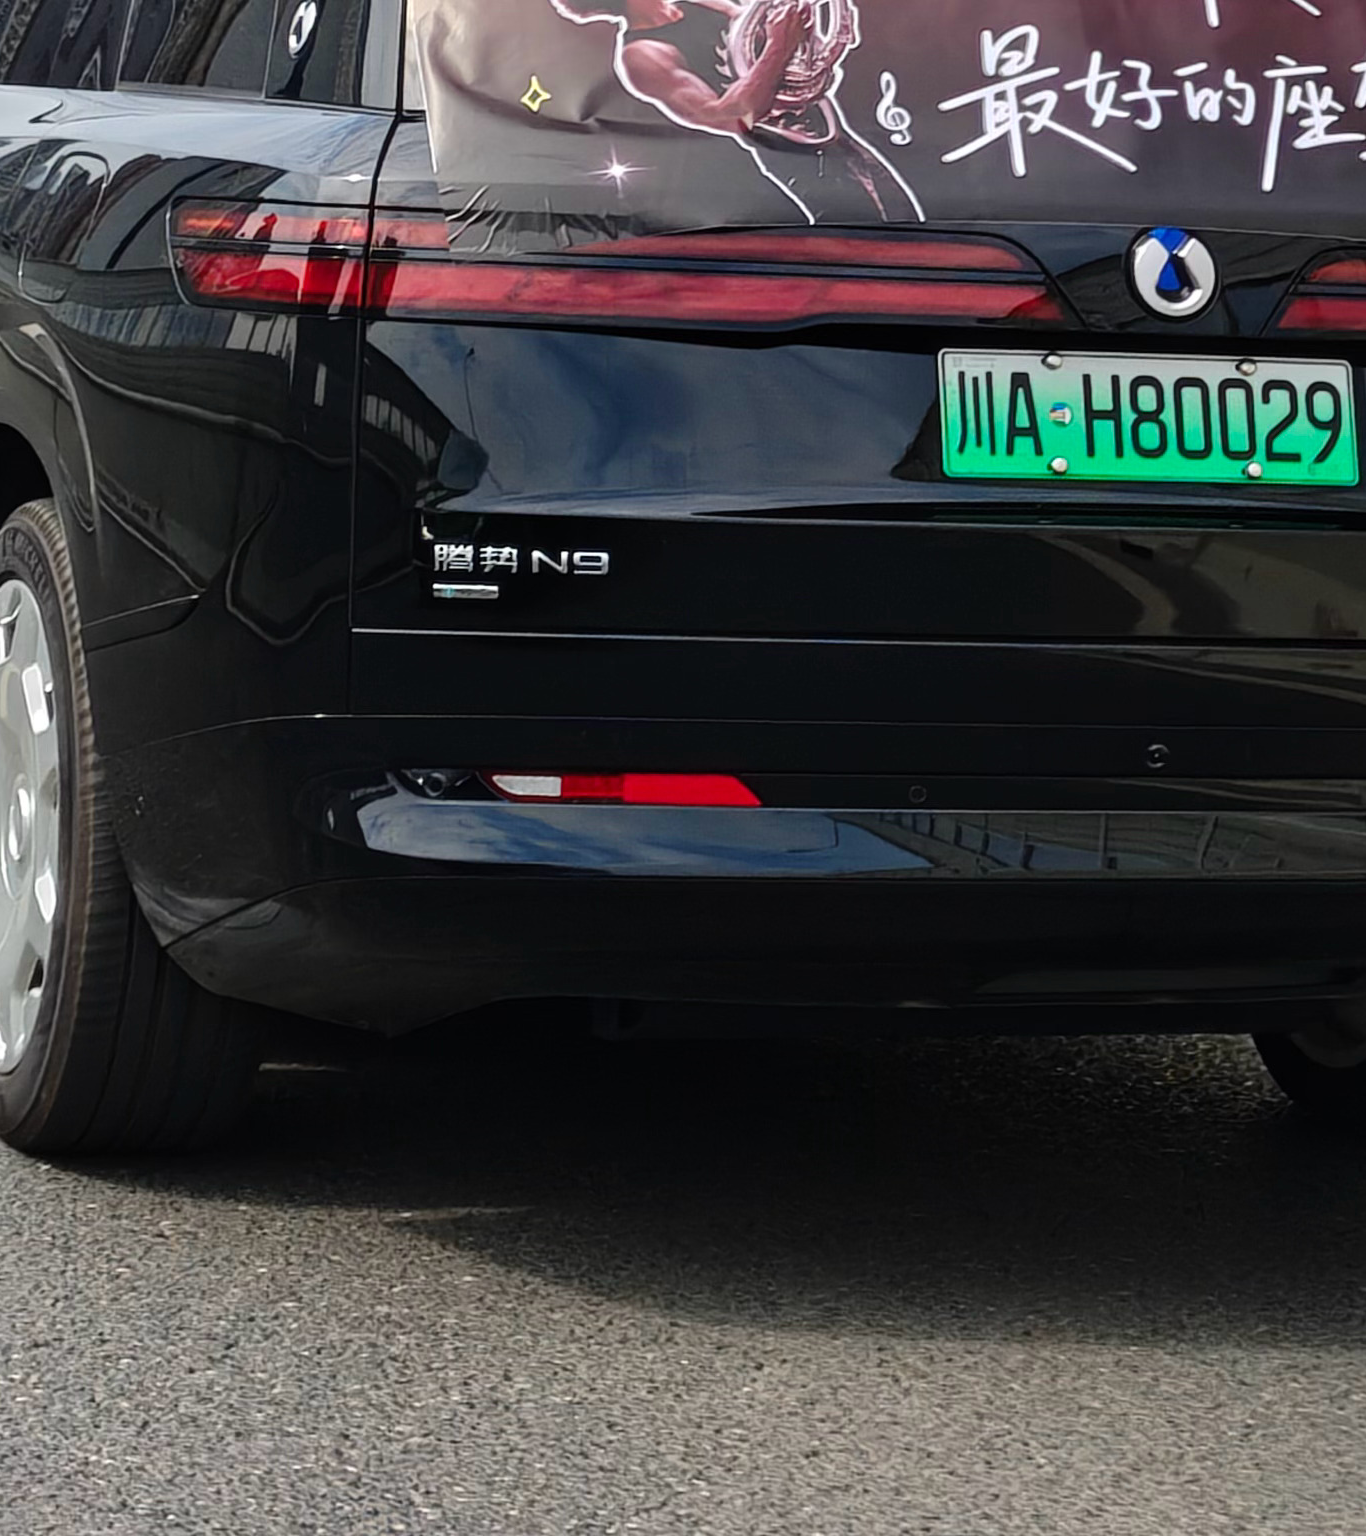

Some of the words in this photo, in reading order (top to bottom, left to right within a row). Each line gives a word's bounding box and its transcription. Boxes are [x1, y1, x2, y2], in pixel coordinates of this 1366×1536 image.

[1081, 373, 1343, 465] H80029
[433, 544, 519, 573] 腾势
[531, 549, 610, 576] N9
